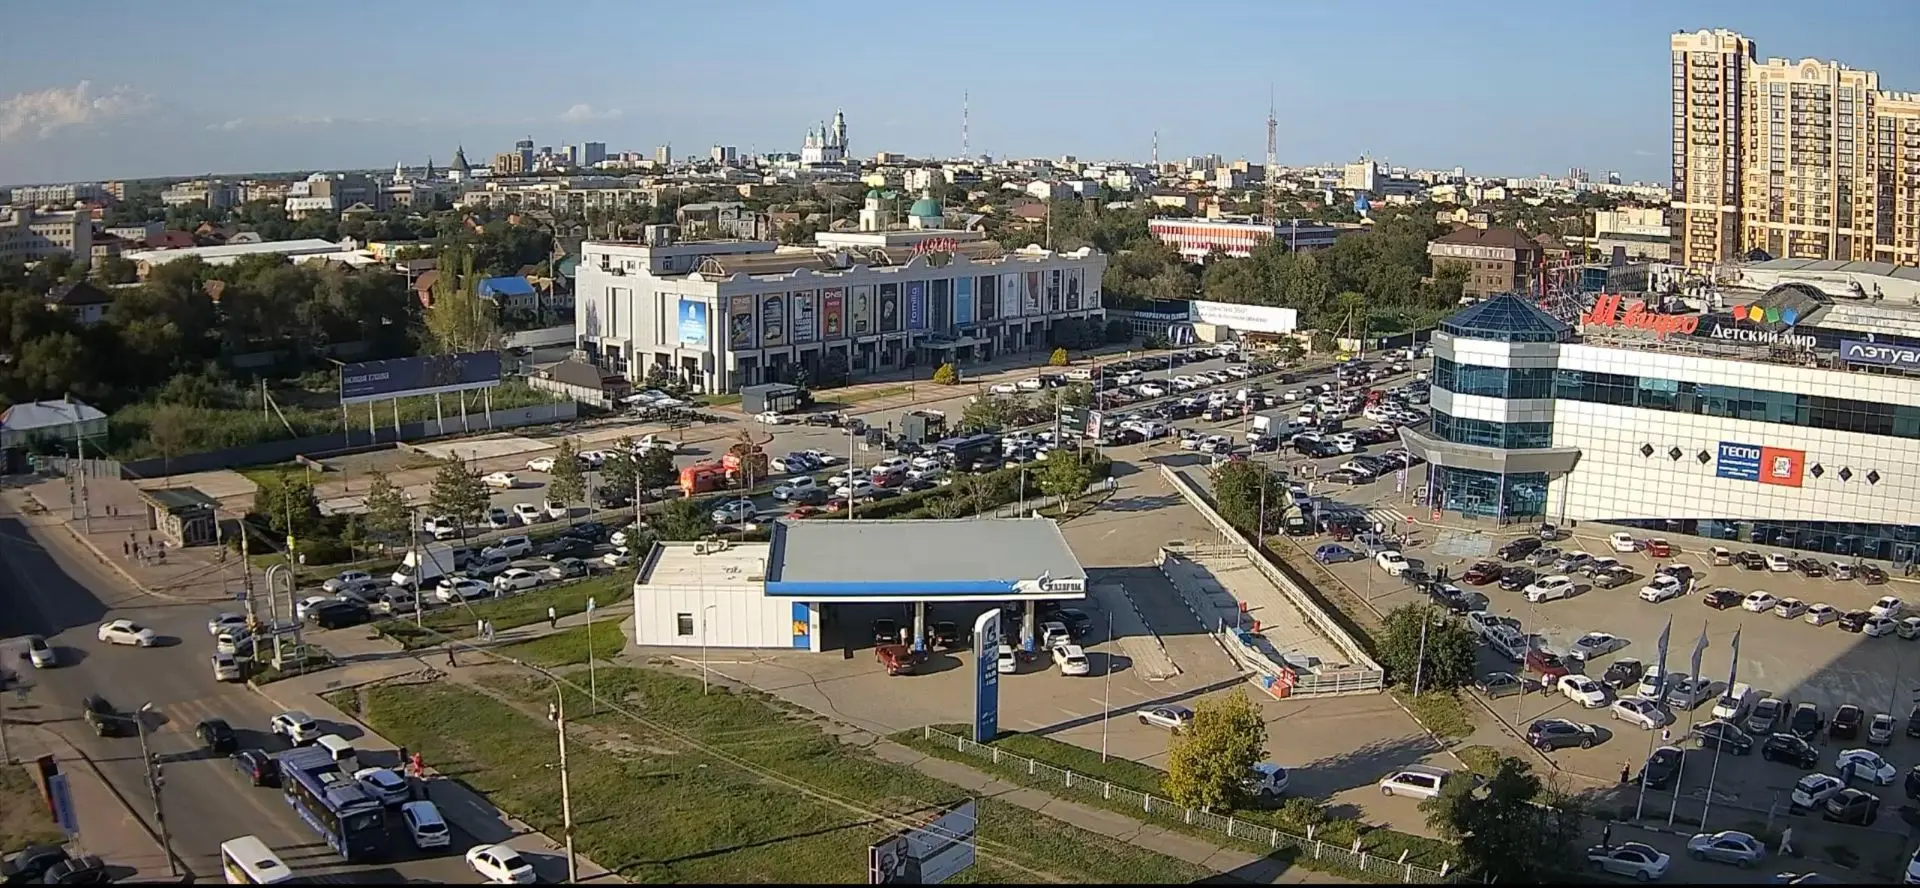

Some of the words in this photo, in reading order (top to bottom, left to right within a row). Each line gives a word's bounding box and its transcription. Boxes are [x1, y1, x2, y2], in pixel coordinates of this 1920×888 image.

[825, 291, 842, 299] DNS
[1710, 322, 1780, 345] Детский
[1783, 333, 1817, 352] мир
